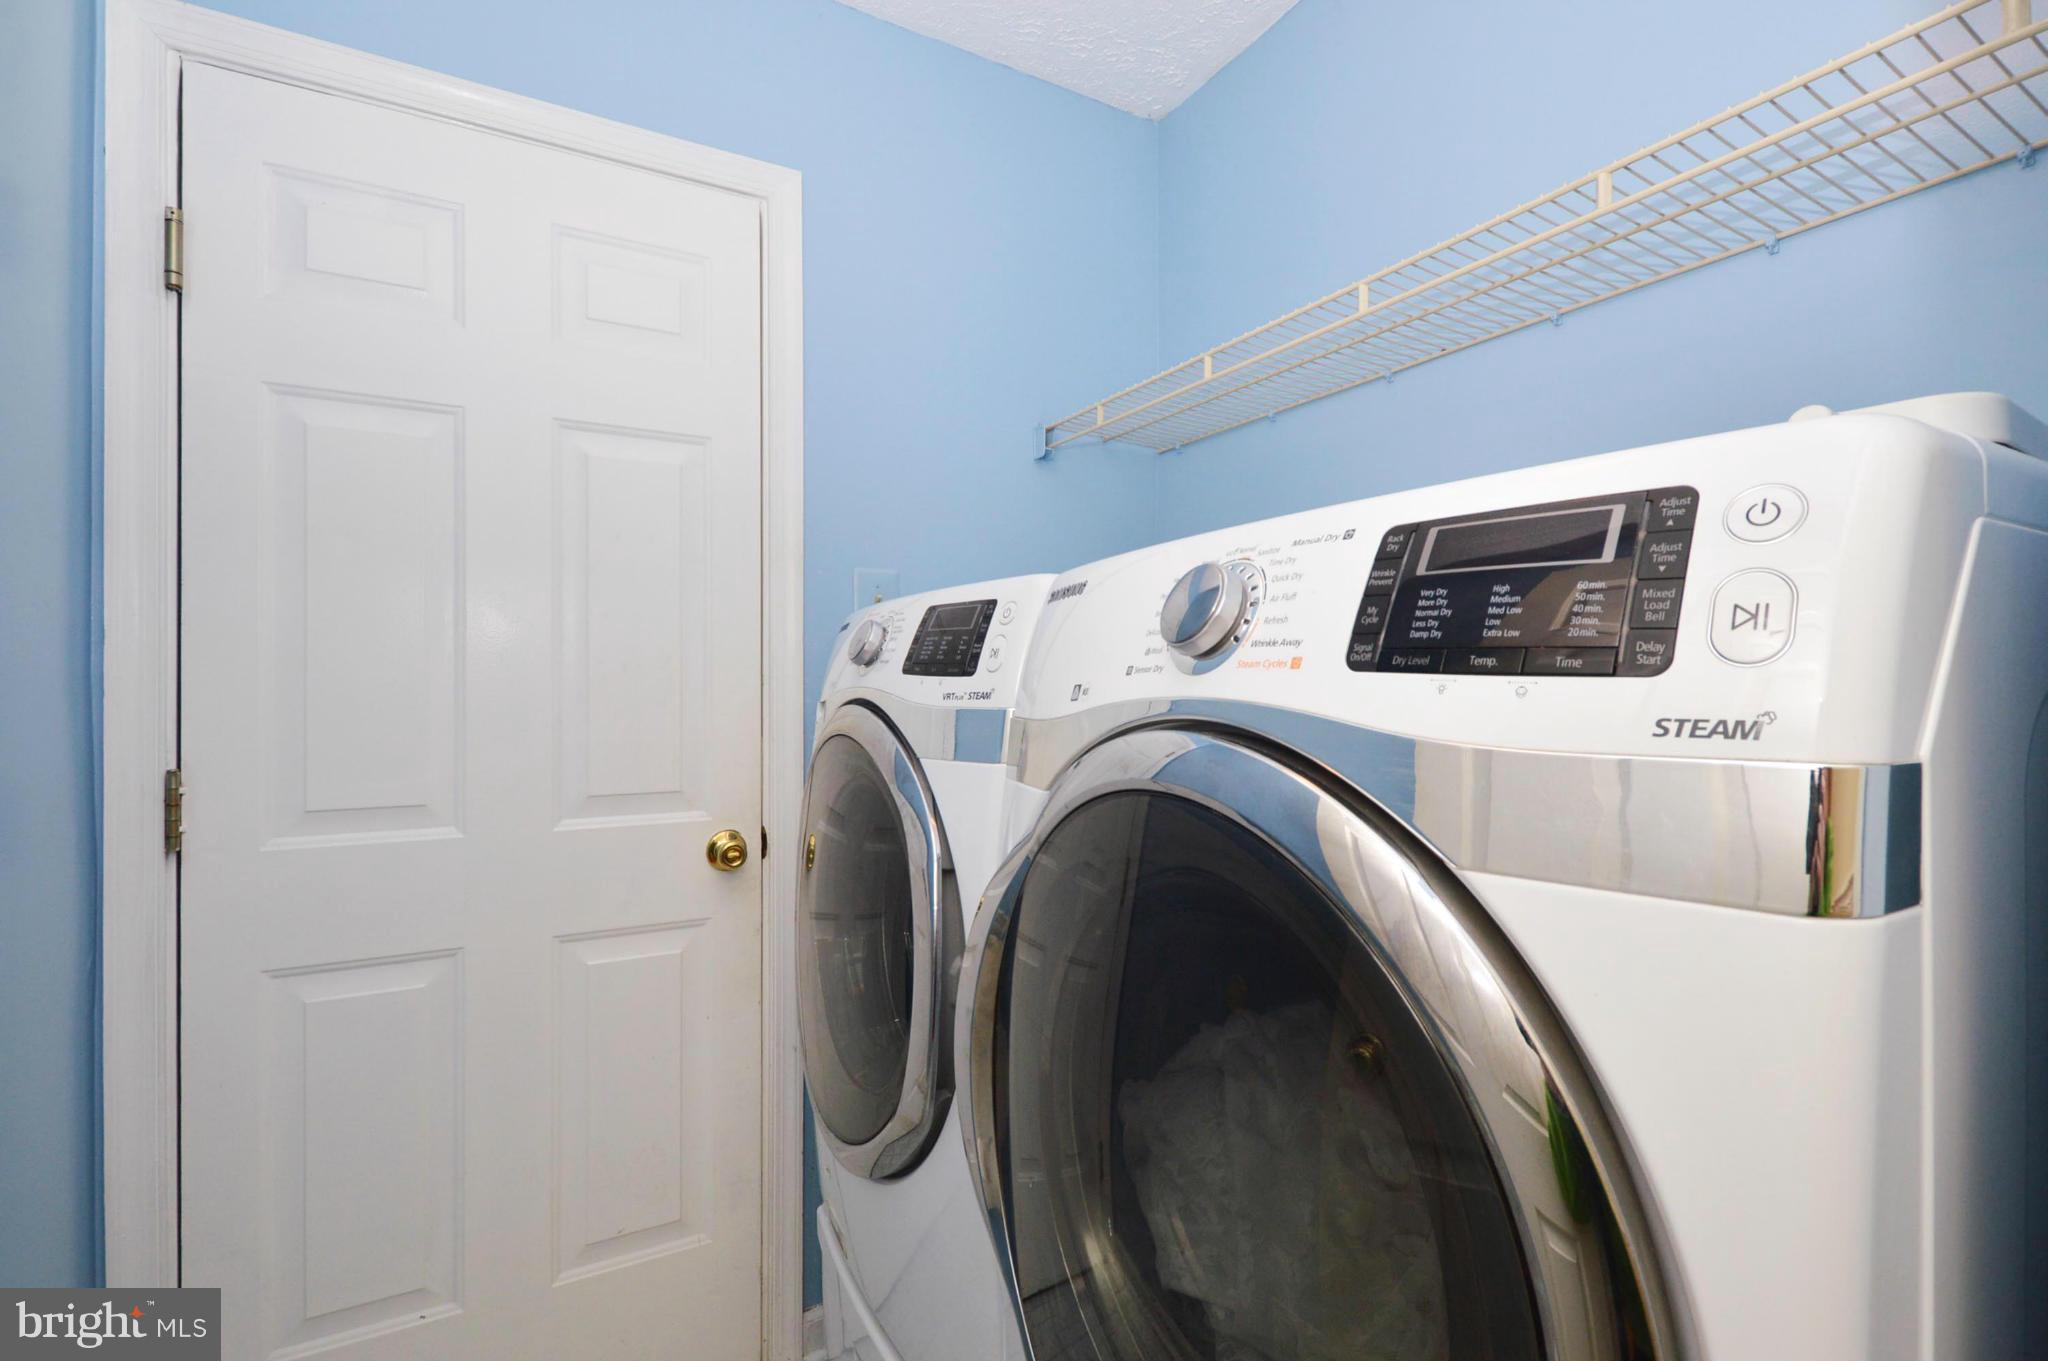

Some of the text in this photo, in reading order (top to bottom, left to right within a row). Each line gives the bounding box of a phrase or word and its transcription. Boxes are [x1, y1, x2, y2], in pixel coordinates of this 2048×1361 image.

[1660, 496, 1692, 510] Adjust
[1662, 507, 1686, 517] Time
[1292, 533, 1341, 547] Manual Dry
[1387, 534, 1404, 542] Rack
[1386, 542, 1400, 552] Dry
[1649, 542, 1682, 557] Adjust
[1653, 553, 1677, 563] Time
[1271, 571, 1305, 584] Quick Dry
[1371, 569, 1396, 578] Wrinkle
[1368, 577, 1394, 587] Prevent
[1577, 580, 1608, 590] 60 min.
[1420, 588, 1448, 598] Very Dry
[1493, 584, 1510, 595] High
[1642, 588, 1676, 600] Mixed
[1490, 595, 1521, 604] Medium
[1575, 592, 1606, 601] 50 min.
[1417, 598, 1448, 608] More Dry
[1644, 600, 1670, 611] Load
[1366, 605, 1378, 616] My
[1415, 608, 1452, 618] Normal Dry
[1488, 606, 1523, 615] Med Low
[1572, 604, 1604, 613] 40 min.
[1263, 616, 1289, 625] Refresh
[1361, 614, 1380, 625] Cycle
[1570, 616, 1601, 625] 30 min.
[1645, 611, 1665, 622] Bell
[1412, 619, 1439, 629] Less Dry
[1485, 618, 1501, 626] Low
[1410, 630, 1442, 640] Damp Dry
[1483, 629, 1520, 638] Extra Low
[1568, 628, 1599, 637] 20 min.
[1251, 639, 1303, 650] Wrinkle Away
[1353, 643, 1374, 653] Signal
[1636, 641, 1666, 655] Delay
[1350, 653, 1372, 662] On/Off
[1392, 655, 1430, 668] Dry Level
[1470, 655, 1499, 668] Temp.
[1556, 656, 1583, 668] Time
[1636, 654, 1661, 665] Start
[1238, 658, 1288, 669] Steam Cycles
[967, 691, 992, 701] STEAM
